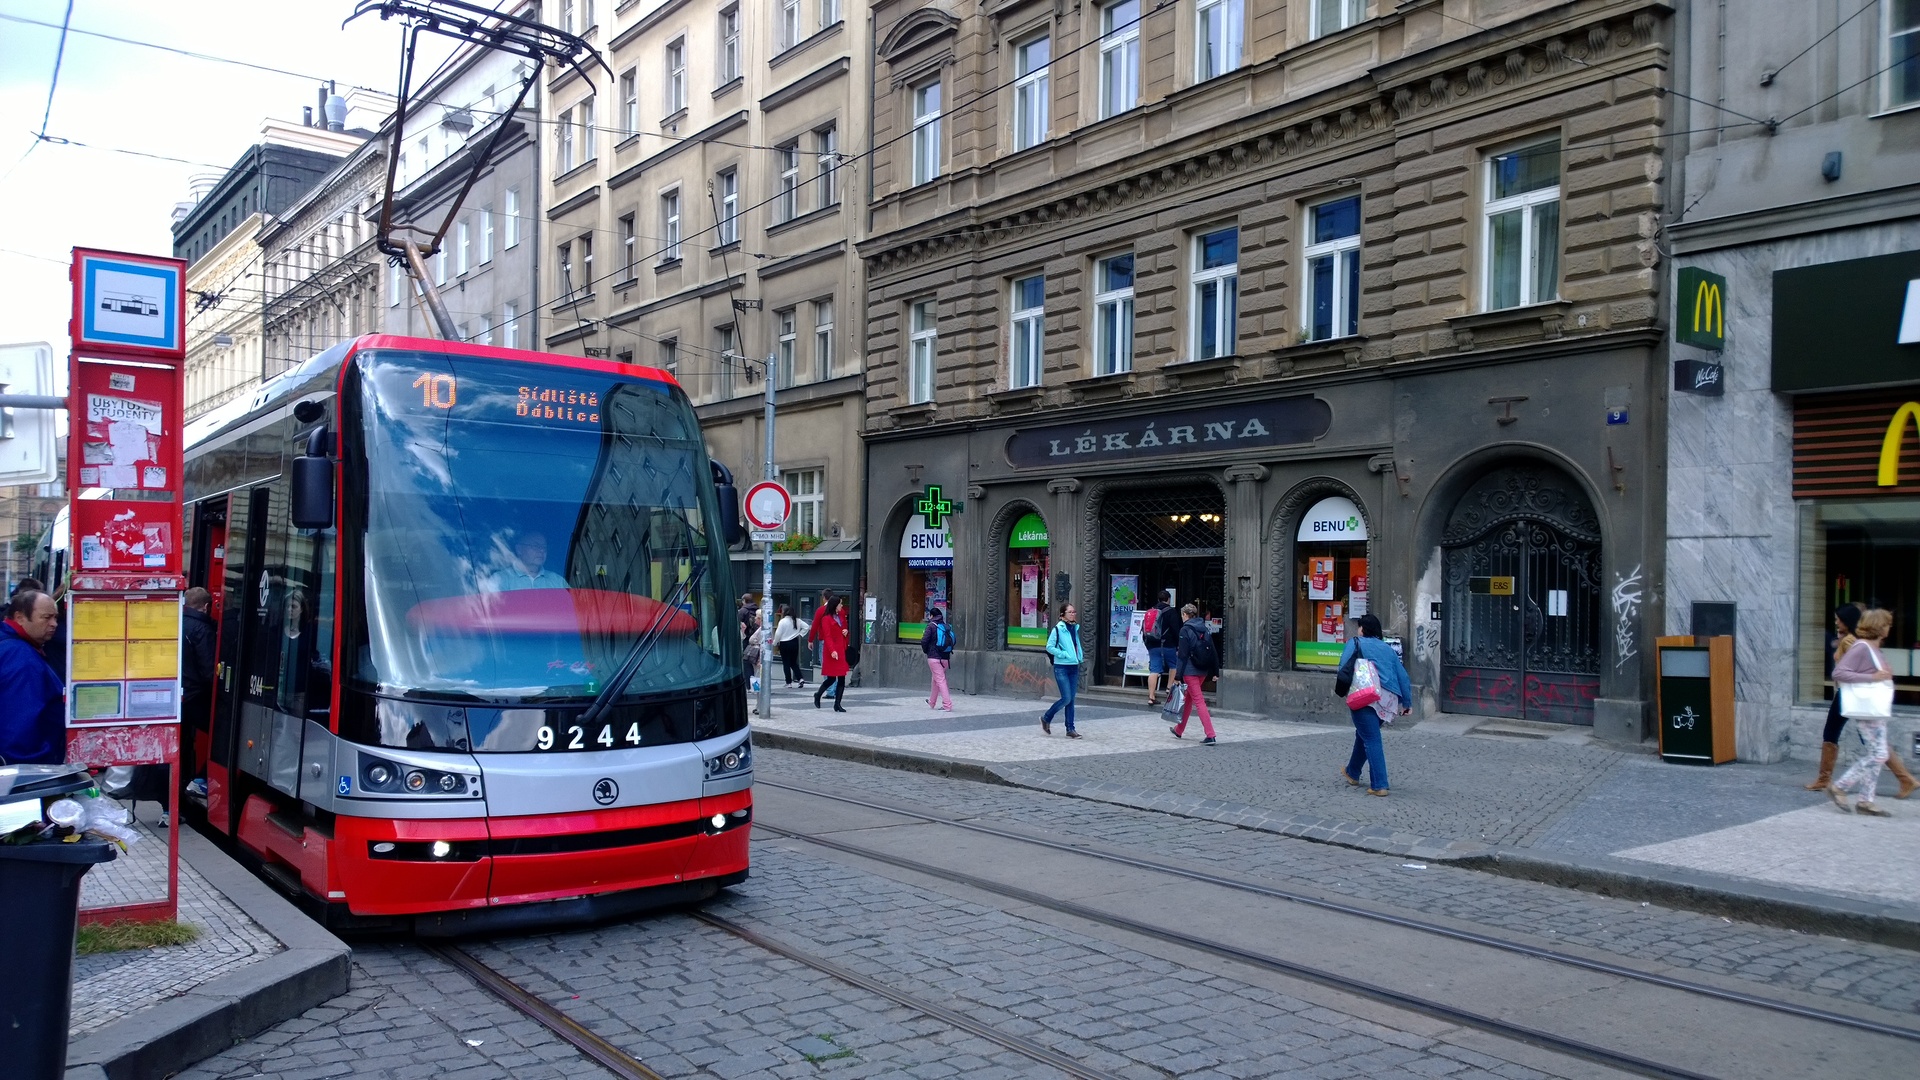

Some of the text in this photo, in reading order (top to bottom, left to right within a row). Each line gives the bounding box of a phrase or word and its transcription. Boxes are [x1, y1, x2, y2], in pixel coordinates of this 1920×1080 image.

[412, 372, 457, 409] 10
[518, 386, 600, 407] Sídliště
[92, 407, 156, 421] STUDENTY
[1613, 410, 1621, 421] 9
[1049, 418, 1270, 456] LÉKÁRNA
[924, 502, 946, 511] 12:44
[1313, 520, 1346, 532] BENU
[911, 533, 944, 549] BENU
[1018, 530, 1048, 541] Lékárna
[908, 559, 925, 567] SOBOTA
[1493, 581, 1509, 590] E&S
[249, 675, 264, 697] 9244
[537, 722, 641, 750] 9244
